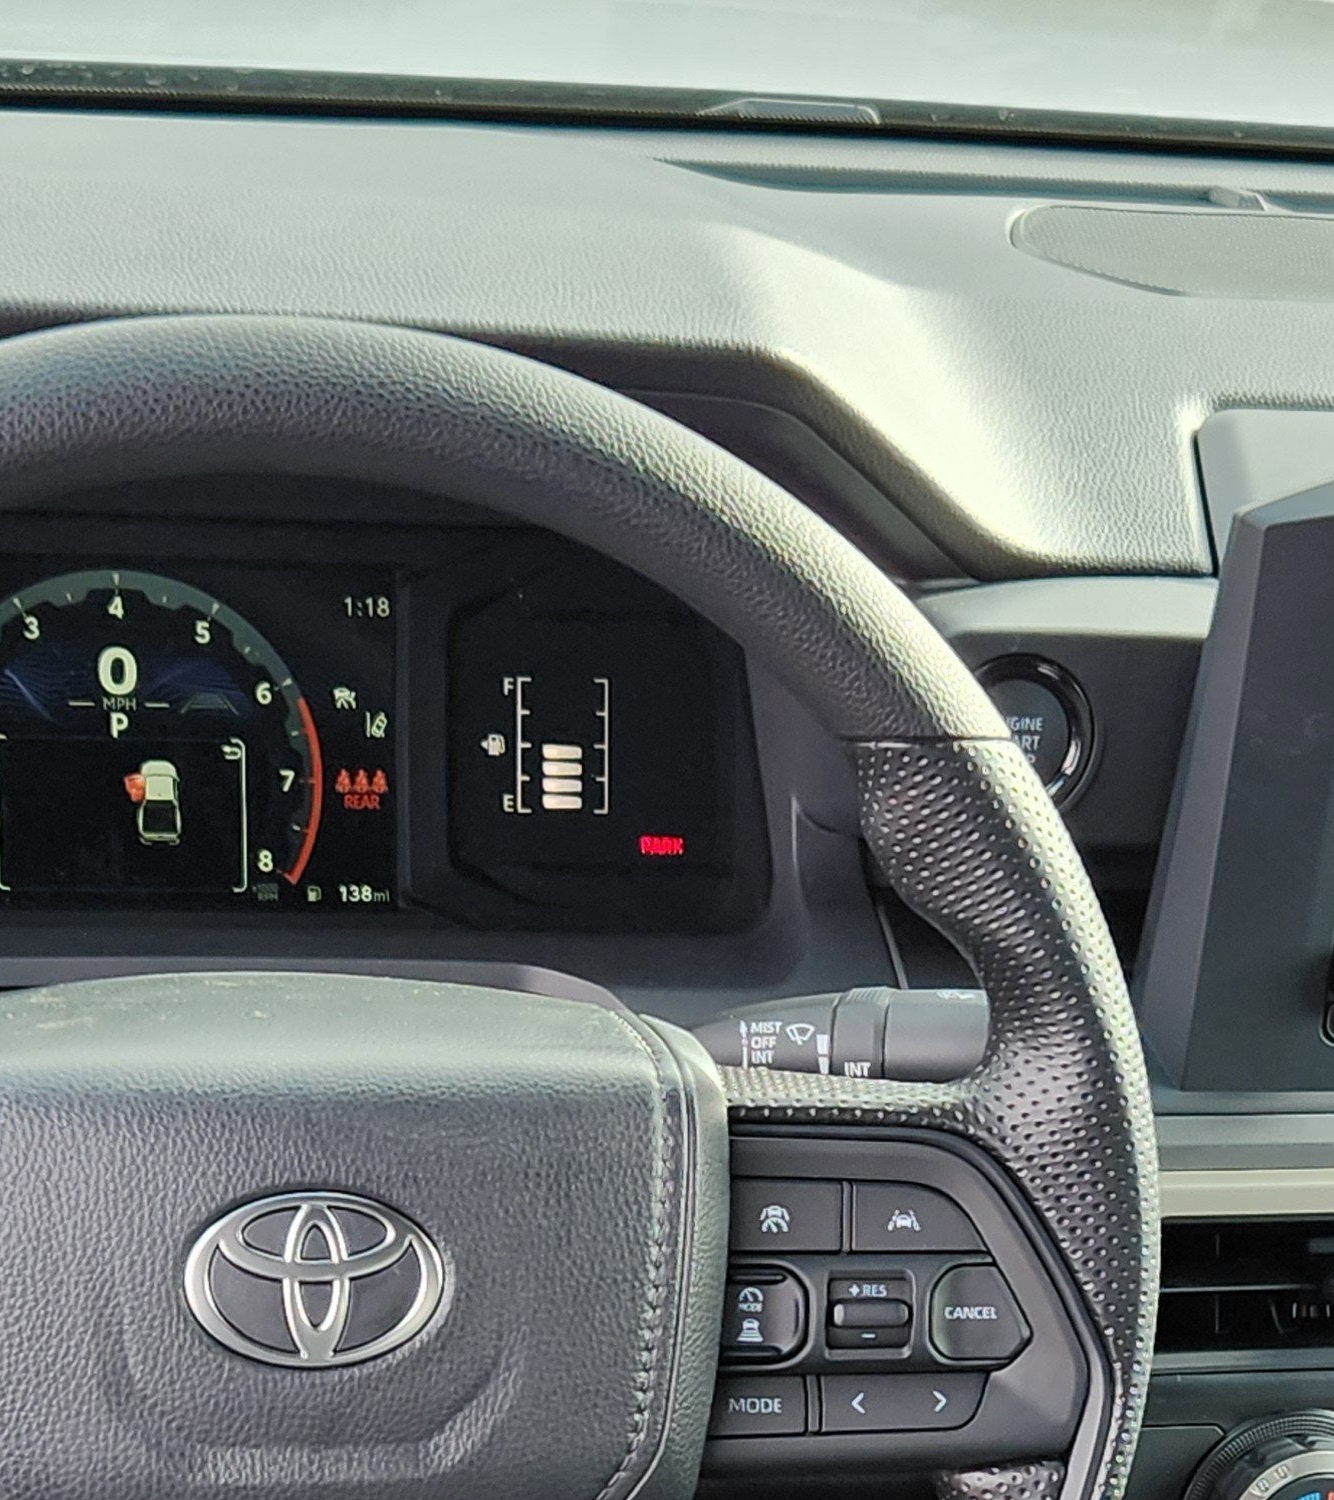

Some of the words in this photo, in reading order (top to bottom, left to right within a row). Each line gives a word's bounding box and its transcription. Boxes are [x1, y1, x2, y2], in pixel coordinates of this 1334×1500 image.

[108, 596, 124, 619] 4
[343, 597, 391, 618] 1:18
[23, 615, 41, 640] 3
[194, 620, 211, 644] 5
[97, 646, 138, 696] 0
[255, 681, 273, 706] 6
[502, 676, 515, 696] F
[102, 698, 137, 711] MPH
[109, 712, 130, 739] P
[1006, 715, 1044, 732] GINE
[279, 769, 296, 793] 7
[343, 794, 381, 811] REAR
[502, 793, 515, 813] E
[257, 849, 274, 873] 8
[750, 1021, 783, 1035] MIST
[750, 1037, 777, 1049] OFF
[750, 1051, 775, 1064] INT
[844, 1061, 871, 1077] INT
[944, 1306, 997, 1320] CANCEL
[728, 1397, 783, 1414] MODE
